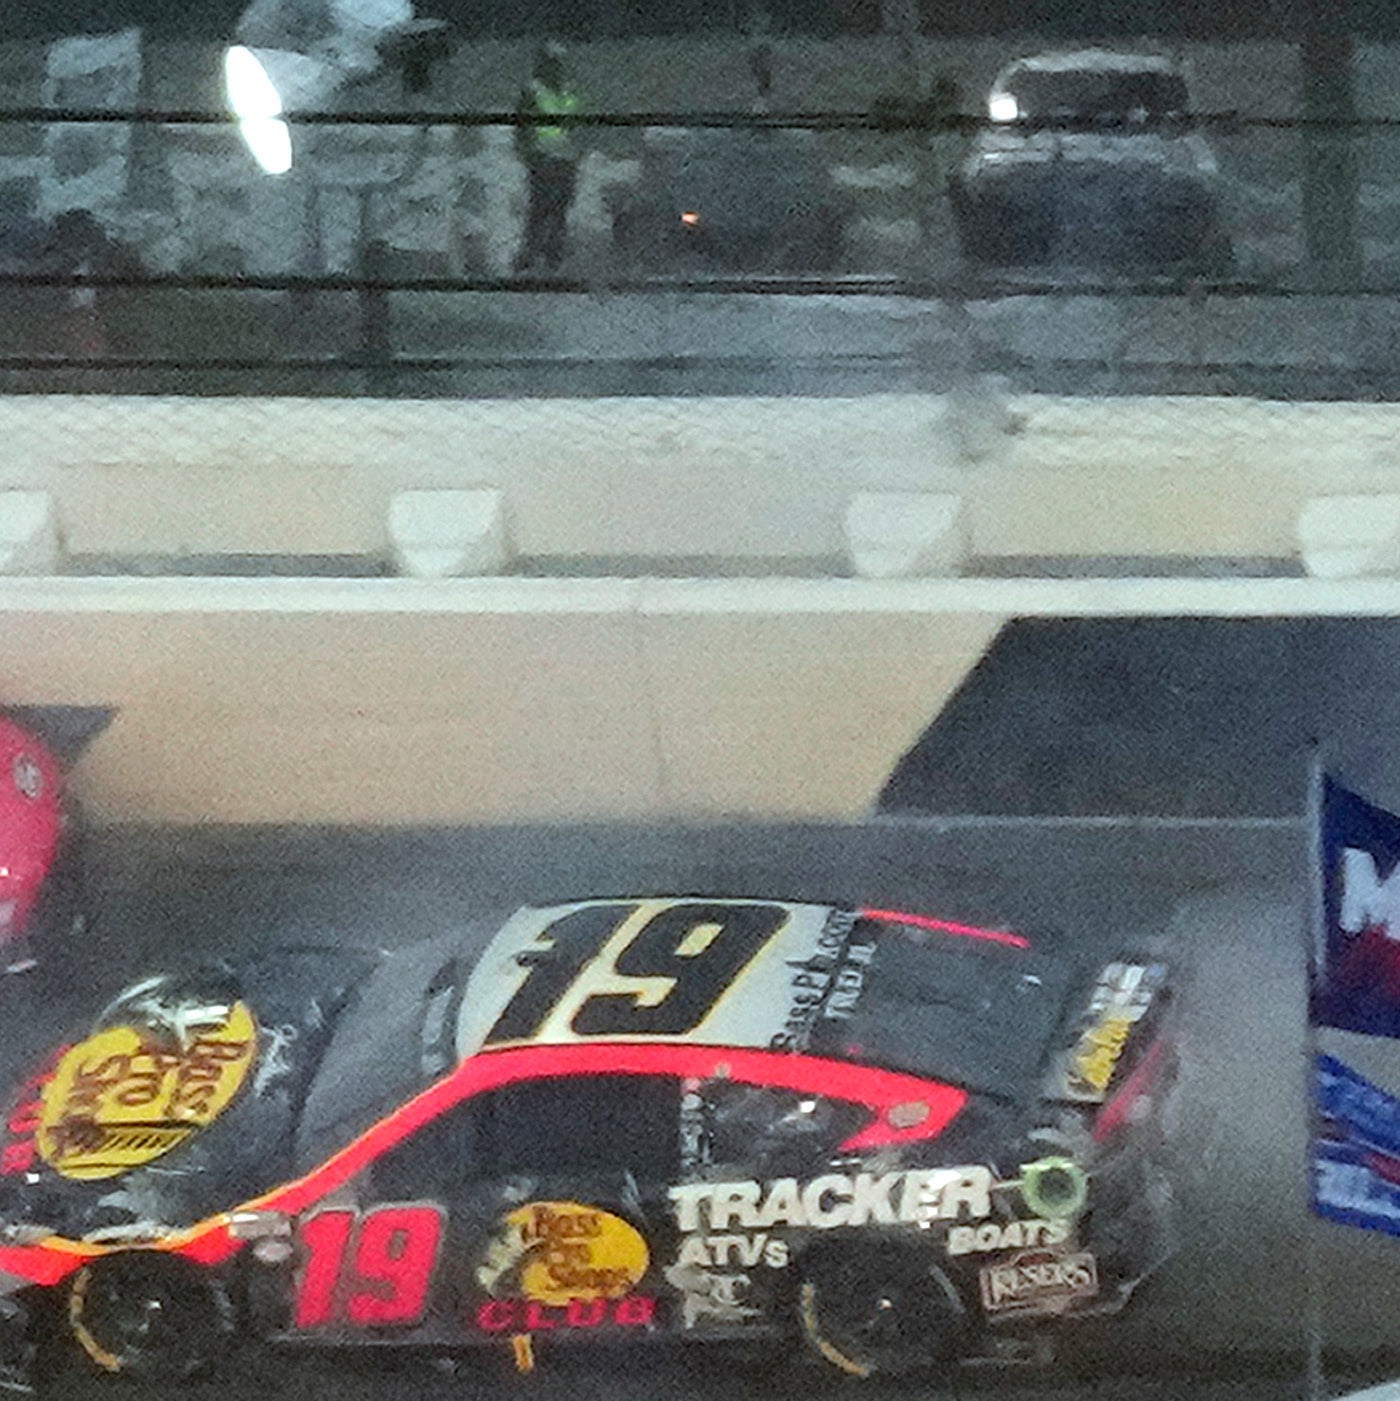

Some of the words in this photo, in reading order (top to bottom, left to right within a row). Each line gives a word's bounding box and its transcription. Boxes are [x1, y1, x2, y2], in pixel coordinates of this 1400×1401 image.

[485, 900, 792, 1043] 19
[668, 1165, 992, 1231] TRACKER
[295, 1203, 444, 1328] 19
[679, 1233, 790, 1269] ATVs
[948, 1219, 1069, 1256] BOATS
